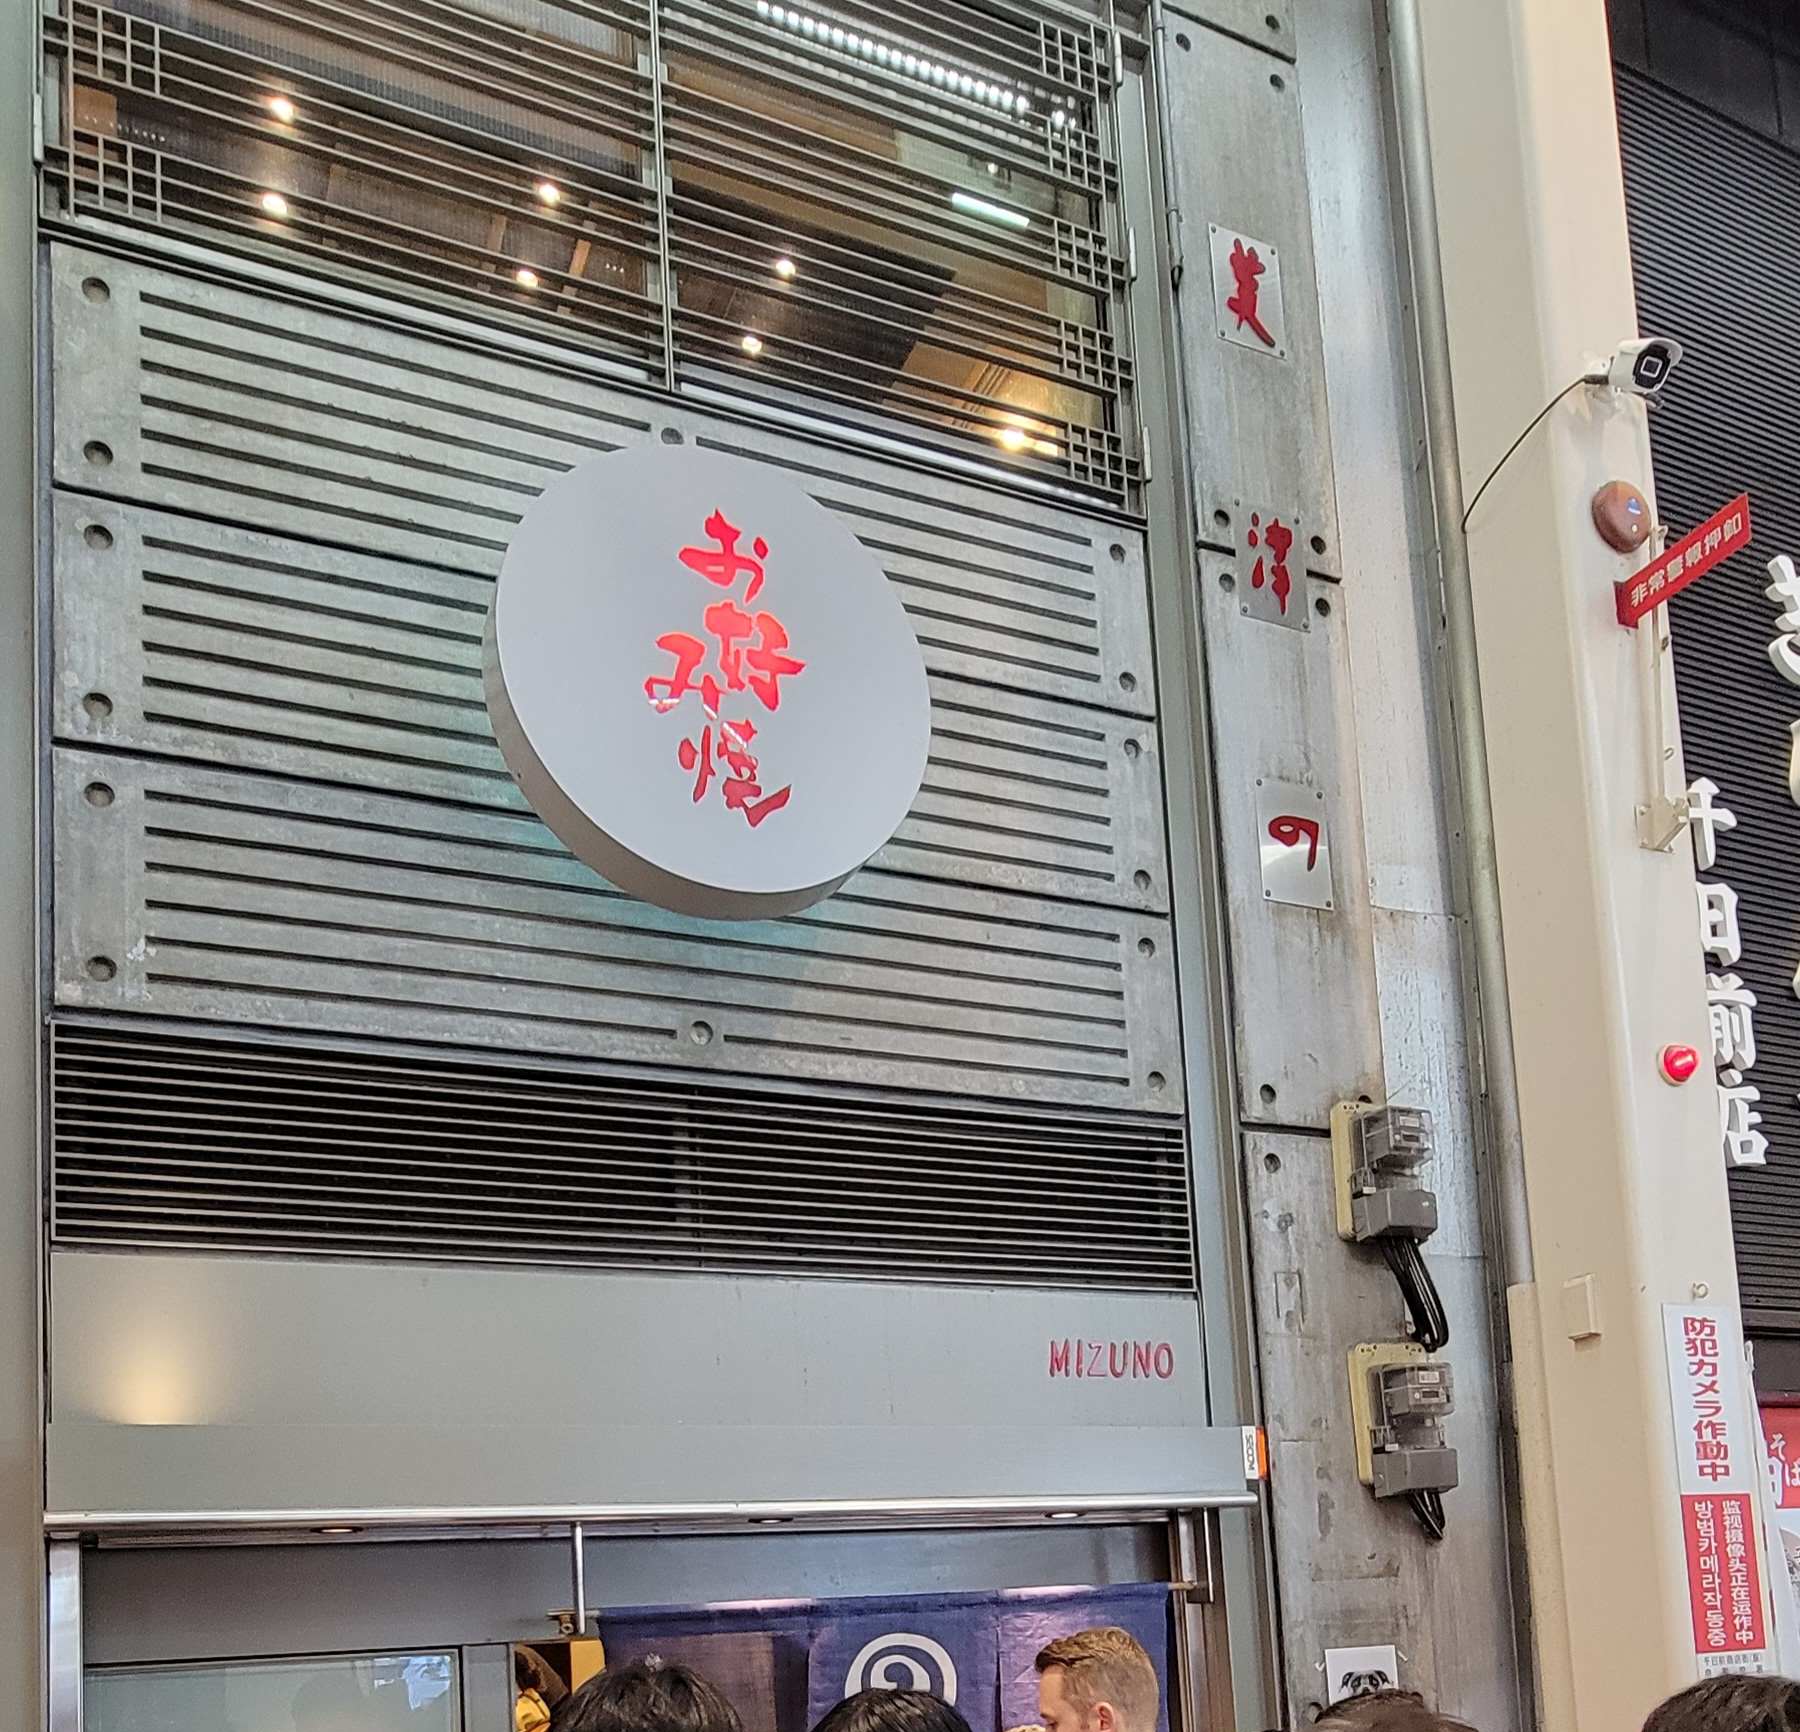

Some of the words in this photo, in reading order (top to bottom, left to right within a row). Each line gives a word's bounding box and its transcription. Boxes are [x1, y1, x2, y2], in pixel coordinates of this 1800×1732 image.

[643, 506, 807, 828] お好み焼
[1048, 1337, 1175, 1380] MIZUNO
[1683, 1316, 1731, 1483] 防犯カメラ作動中
[1694, 1501, 1727, 1647] 방범카메라작동중
